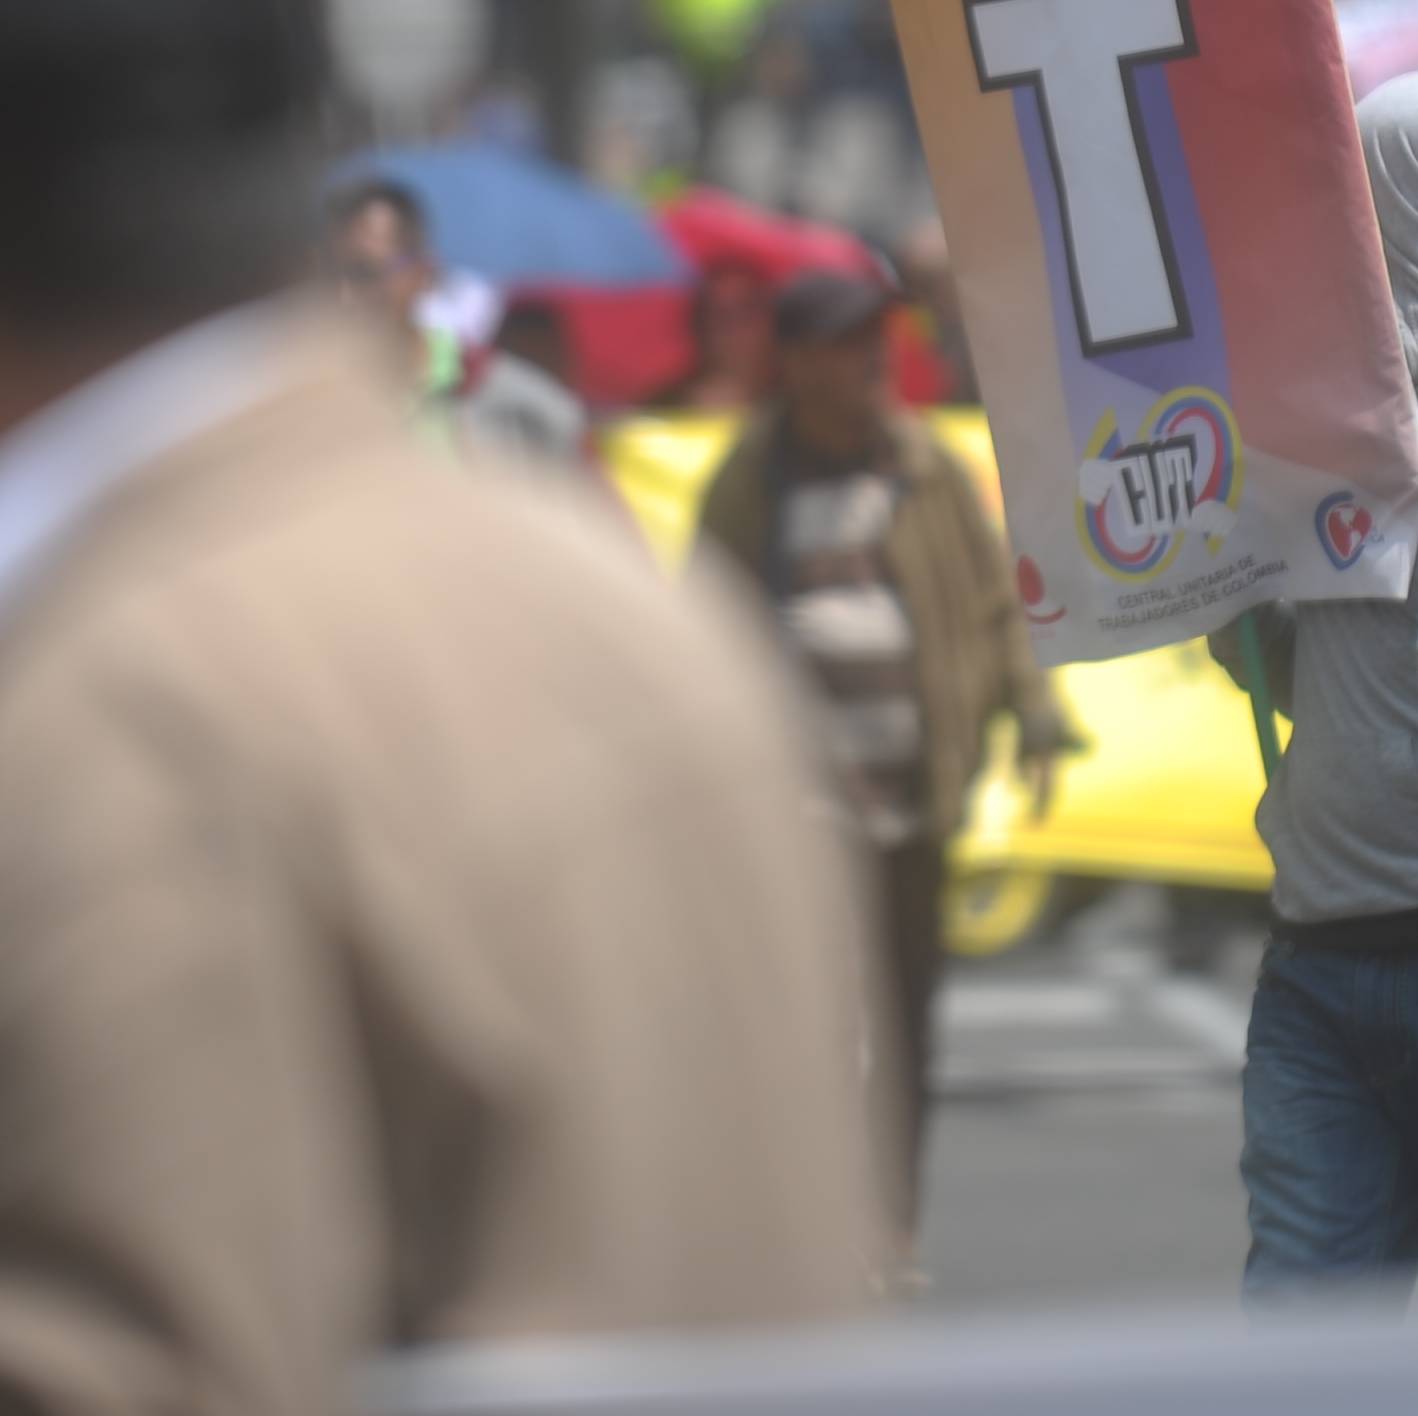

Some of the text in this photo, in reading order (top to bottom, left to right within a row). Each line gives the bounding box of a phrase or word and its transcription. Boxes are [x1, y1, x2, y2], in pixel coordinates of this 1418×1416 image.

[1113, 433, 1196, 535] CUT
[1098, 558, 1289, 632] TRABAJADORES DE COLOMBIA
[1118, 553, 1257, 609] CENTRAL UNITARIA DE
